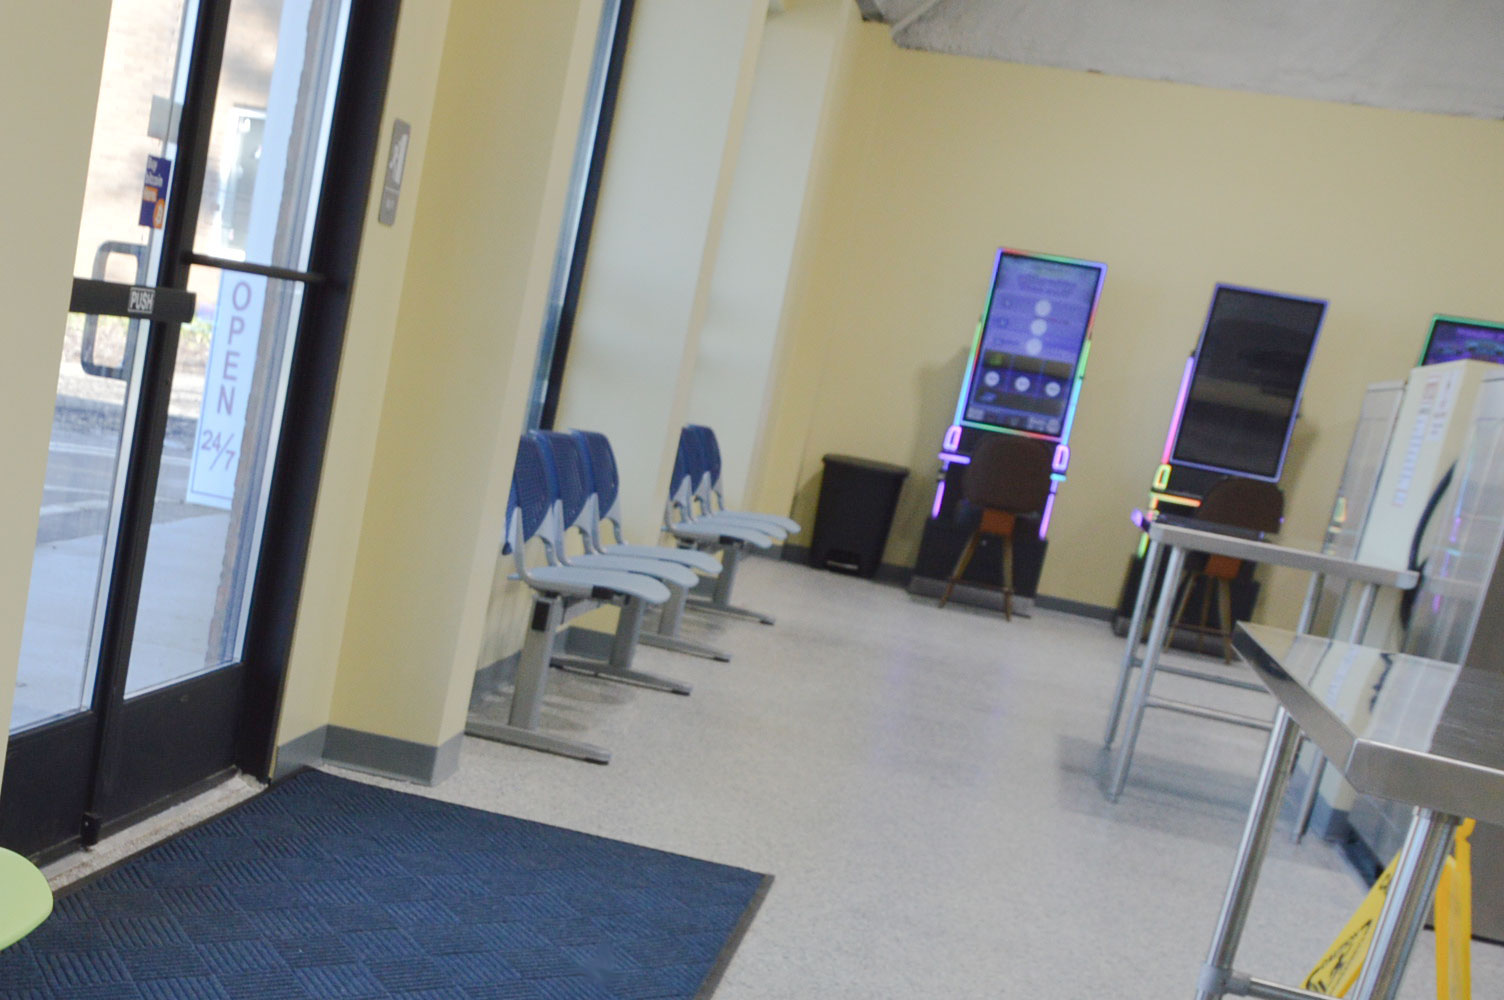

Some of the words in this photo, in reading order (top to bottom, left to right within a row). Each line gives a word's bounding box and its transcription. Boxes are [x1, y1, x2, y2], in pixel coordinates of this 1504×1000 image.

[129, 290, 155, 311] PUSH
[216, 281, 252, 417] OPEN
[201, 429, 237, 471] 24/7
